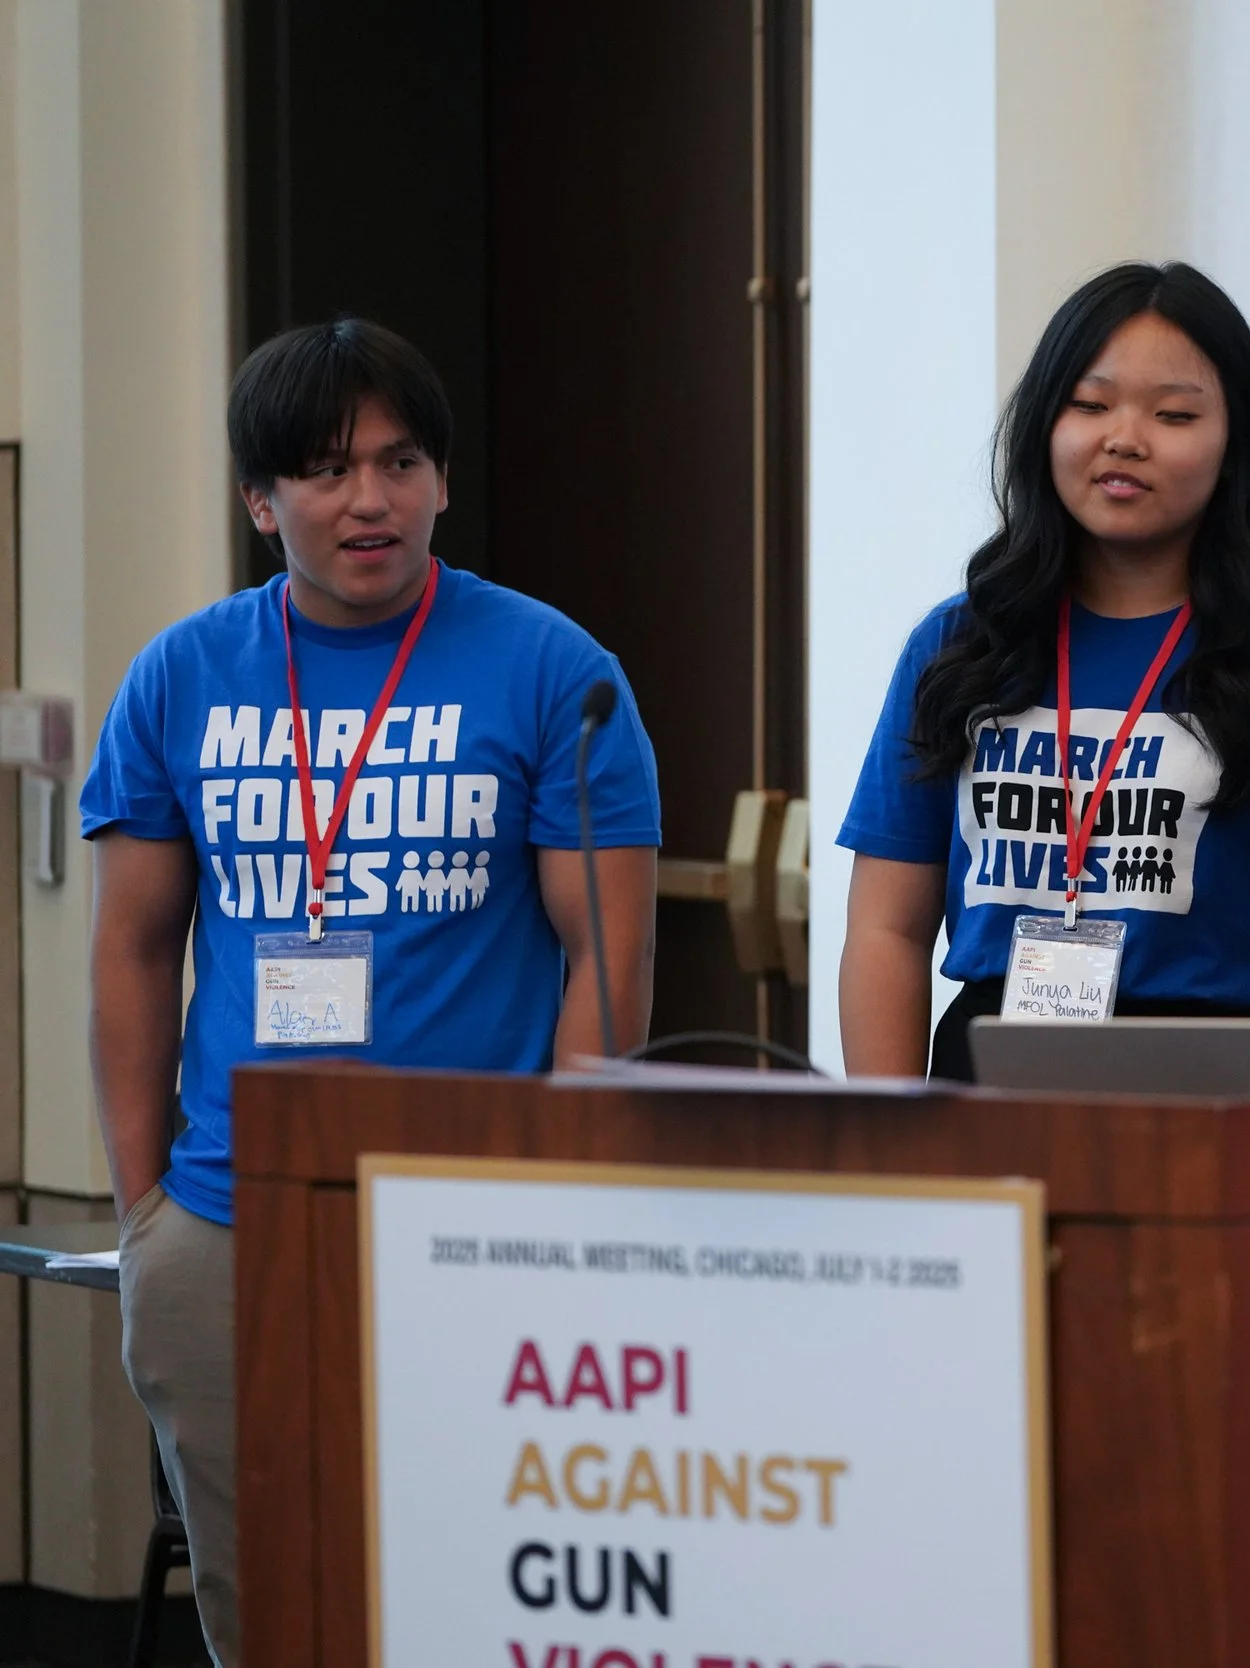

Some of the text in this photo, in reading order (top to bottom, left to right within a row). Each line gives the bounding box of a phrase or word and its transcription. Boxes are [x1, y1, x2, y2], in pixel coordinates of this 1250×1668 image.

[200, 704, 462, 769] MARCH
[972, 727, 1164, 781] MARCH
[202, 774, 499, 844] FOR OUR
[972, 781, 1185, 839] FOR OUR
[211, 851, 390, 919] LIVES
[976, 839, 1111, 893] LIVES
[324, 1002, 338, 1022] A
[1022, 977, 1101, 1004] Junya Liu
[503, 1339, 691, 1415] AAPI
[506, 1440, 849, 1527] AGAINST
[510, 1541, 674, 1618] GUN
